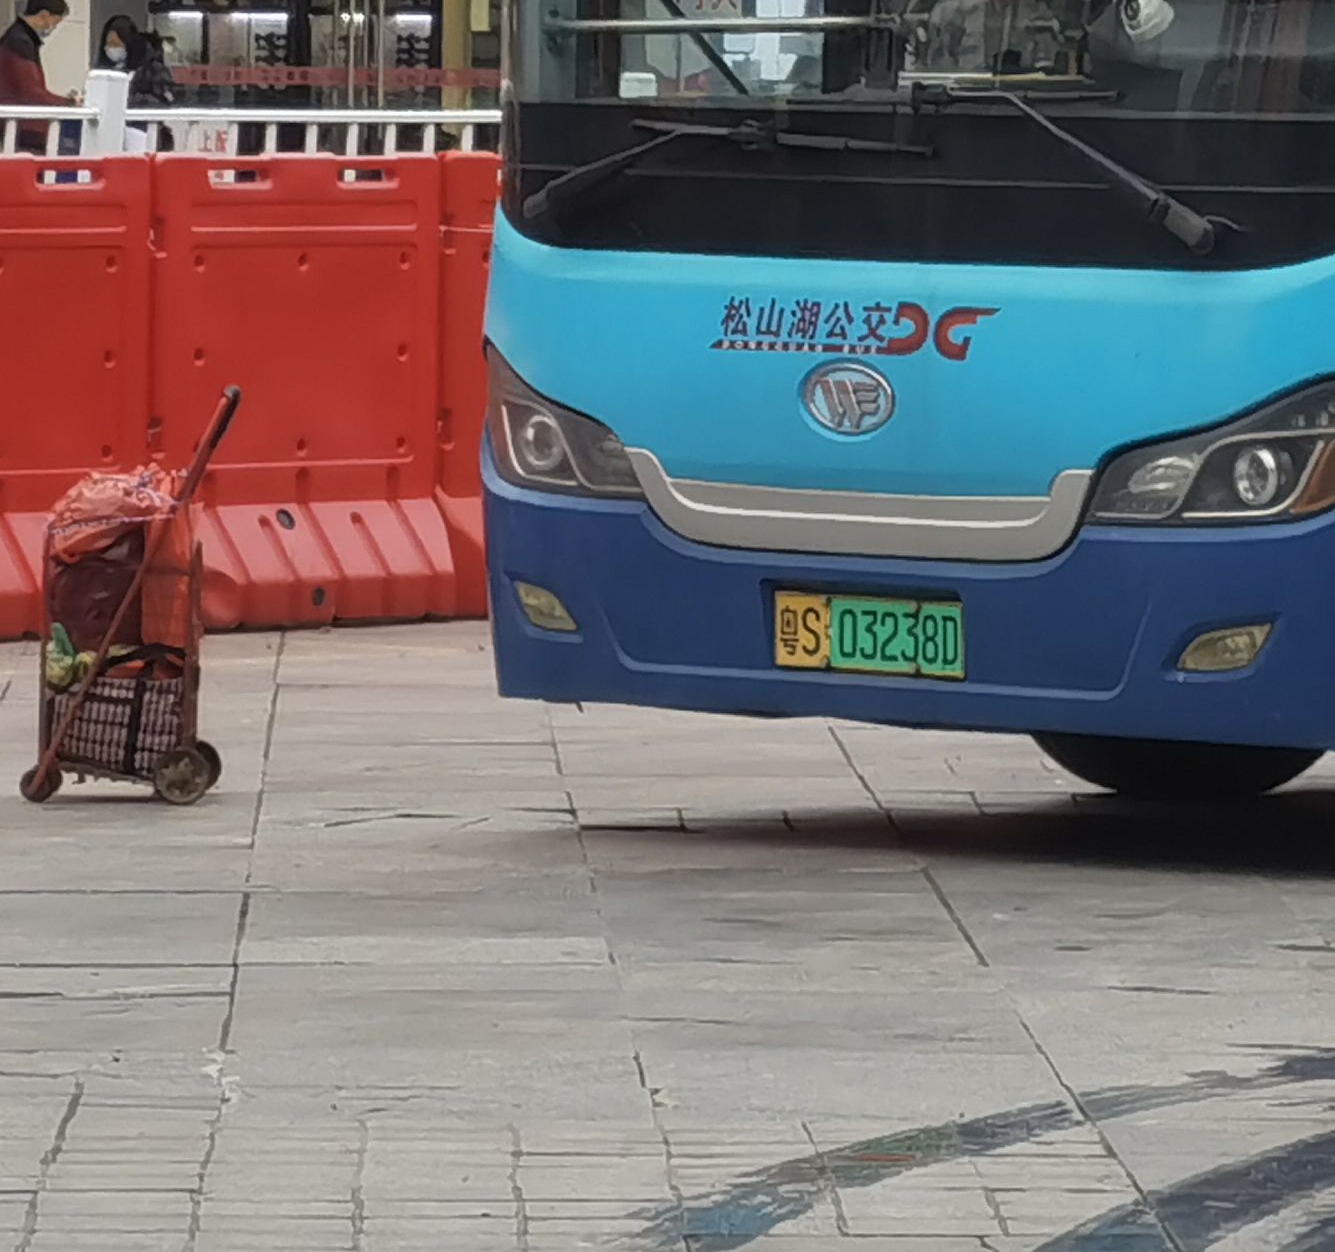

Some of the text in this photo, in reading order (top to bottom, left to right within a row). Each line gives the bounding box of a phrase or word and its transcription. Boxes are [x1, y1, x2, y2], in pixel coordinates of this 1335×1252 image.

[719, 296, 893, 344] 松山湖公交
[838, 607, 959, 666] 03238D
